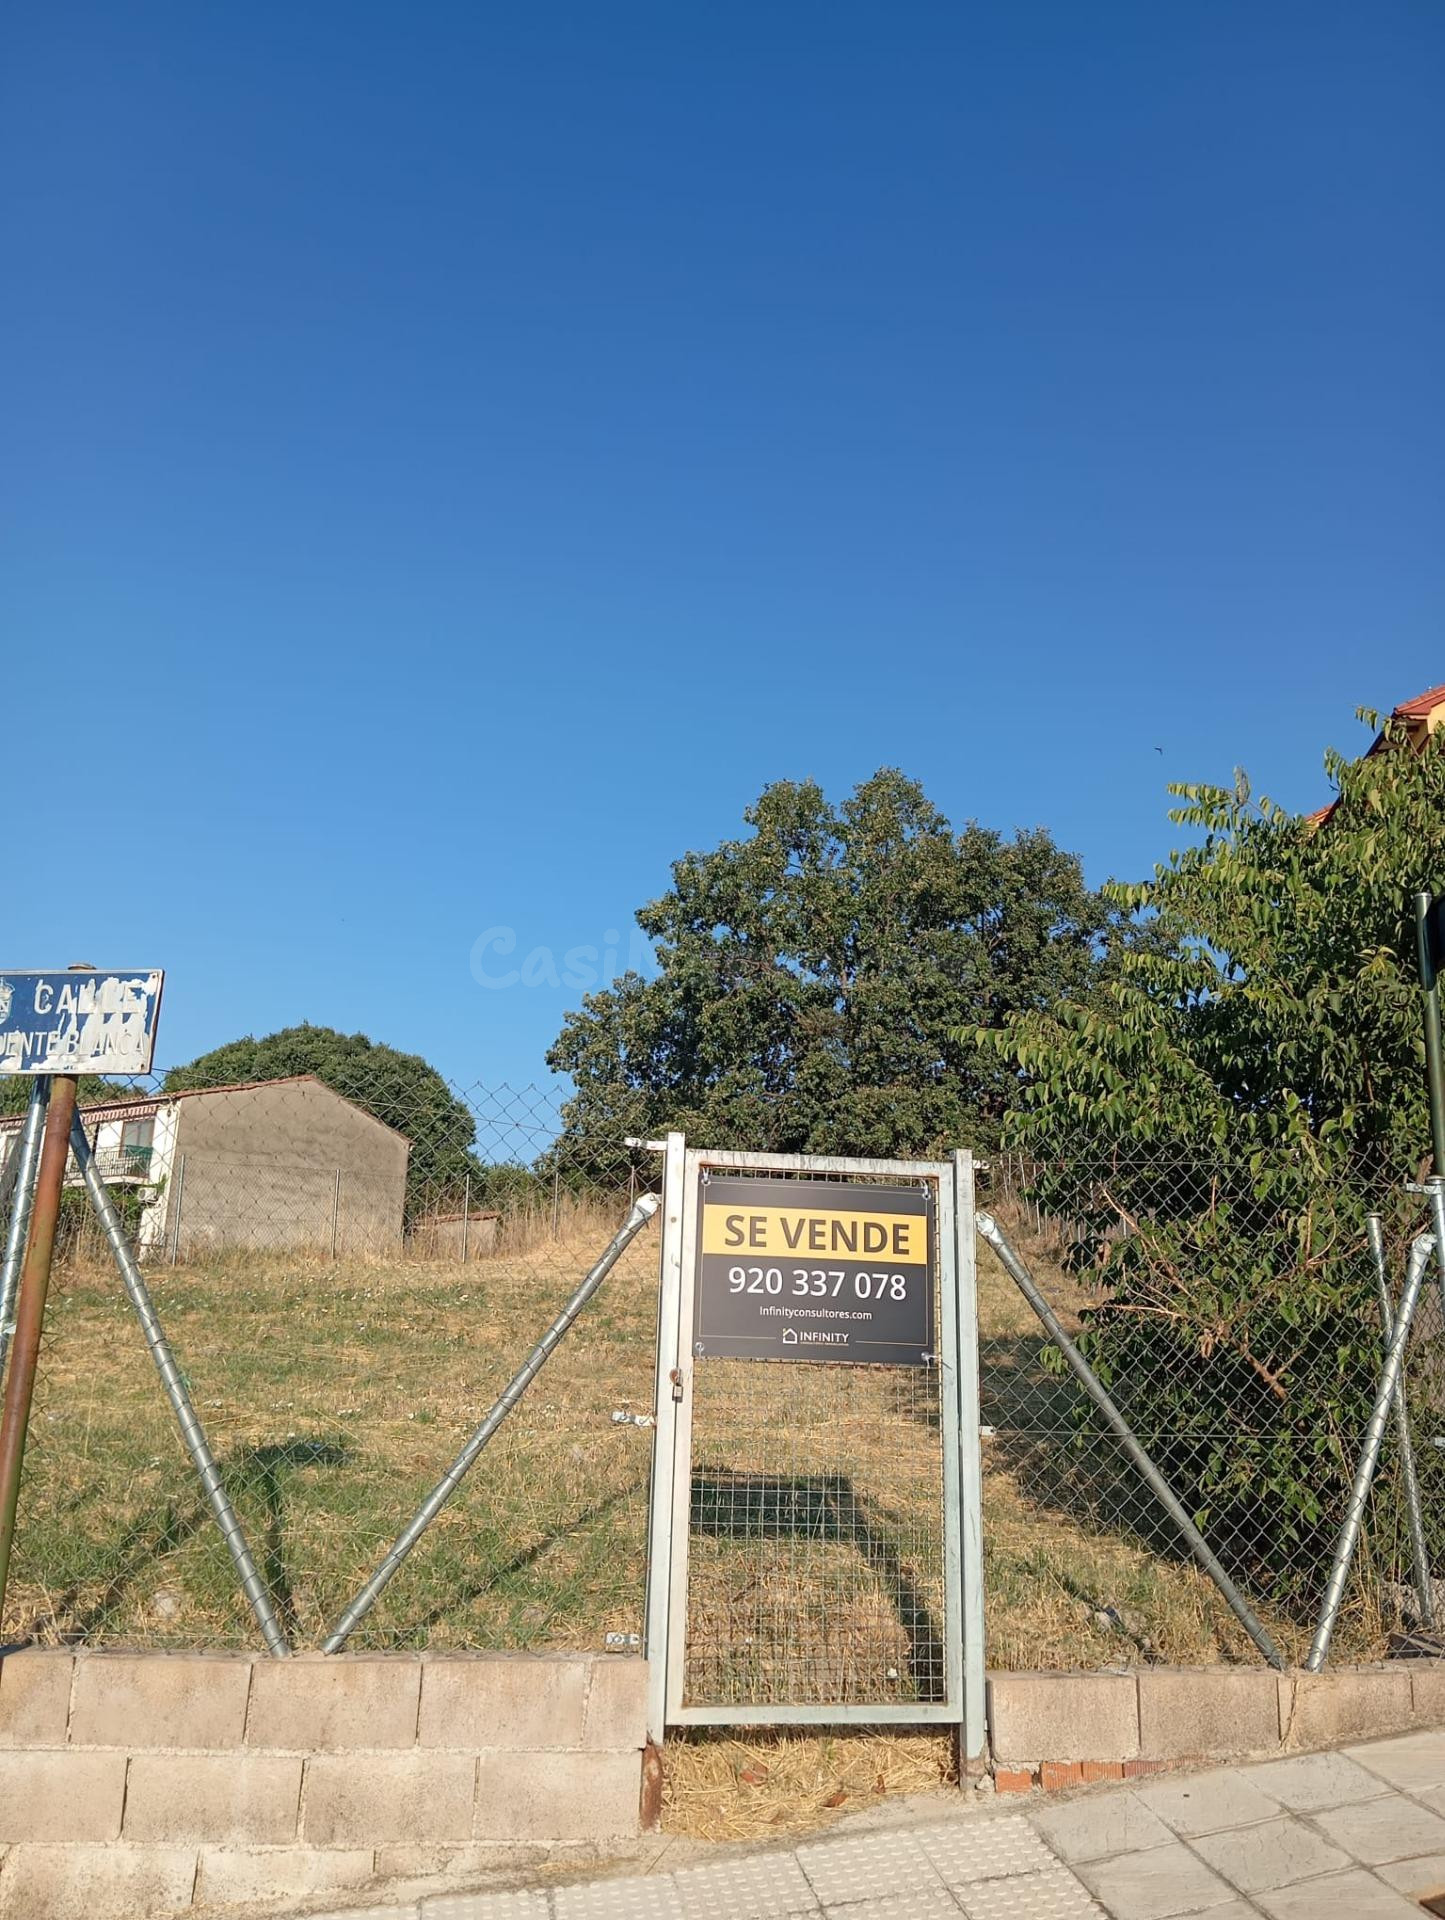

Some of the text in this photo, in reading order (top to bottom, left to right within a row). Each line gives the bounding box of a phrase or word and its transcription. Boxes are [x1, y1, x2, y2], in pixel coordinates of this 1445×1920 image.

[724, 1214, 910, 1255] SE VENDE
[728, 1266, 906, 1300] 920 337 078
[800, 1331, 849, 1342] INFINITY
